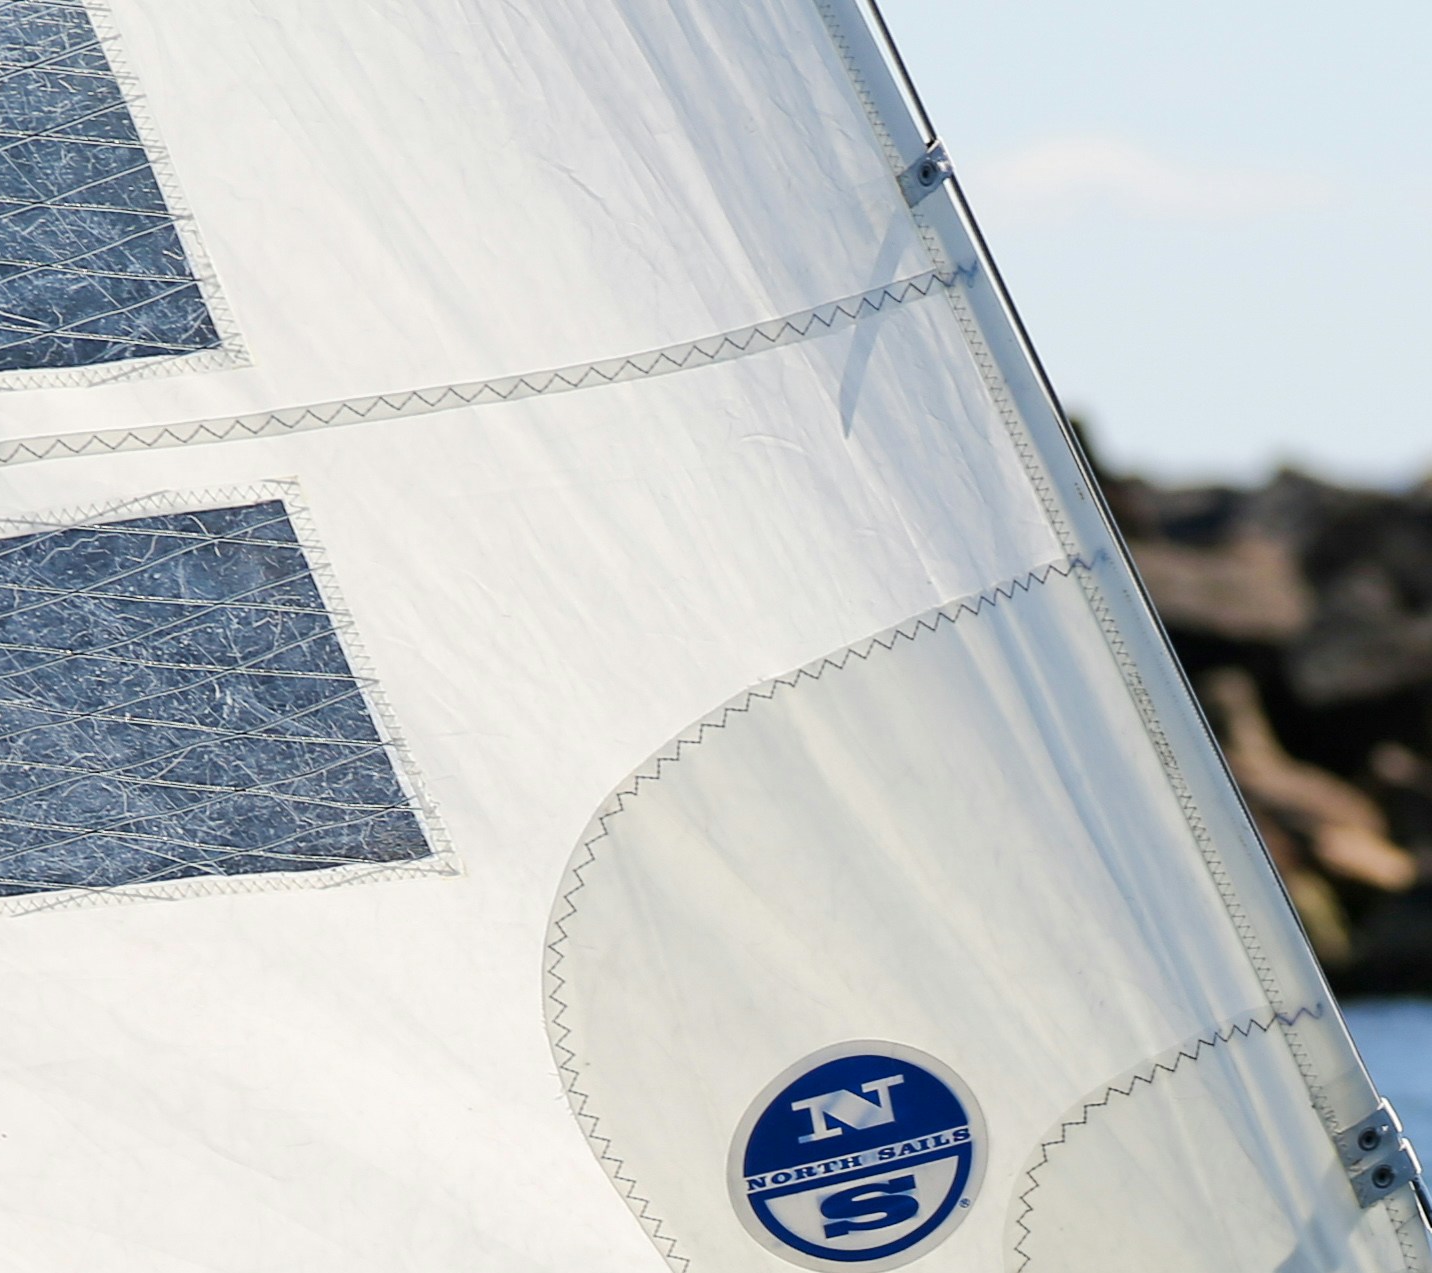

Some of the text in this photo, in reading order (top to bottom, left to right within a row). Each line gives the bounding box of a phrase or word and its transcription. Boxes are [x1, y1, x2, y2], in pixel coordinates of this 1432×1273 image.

[791, 1074, 905, 1144] N
[746, 1127, 971, 1192] NORTH SAILS
[820, 1174, 920, 1239] S
